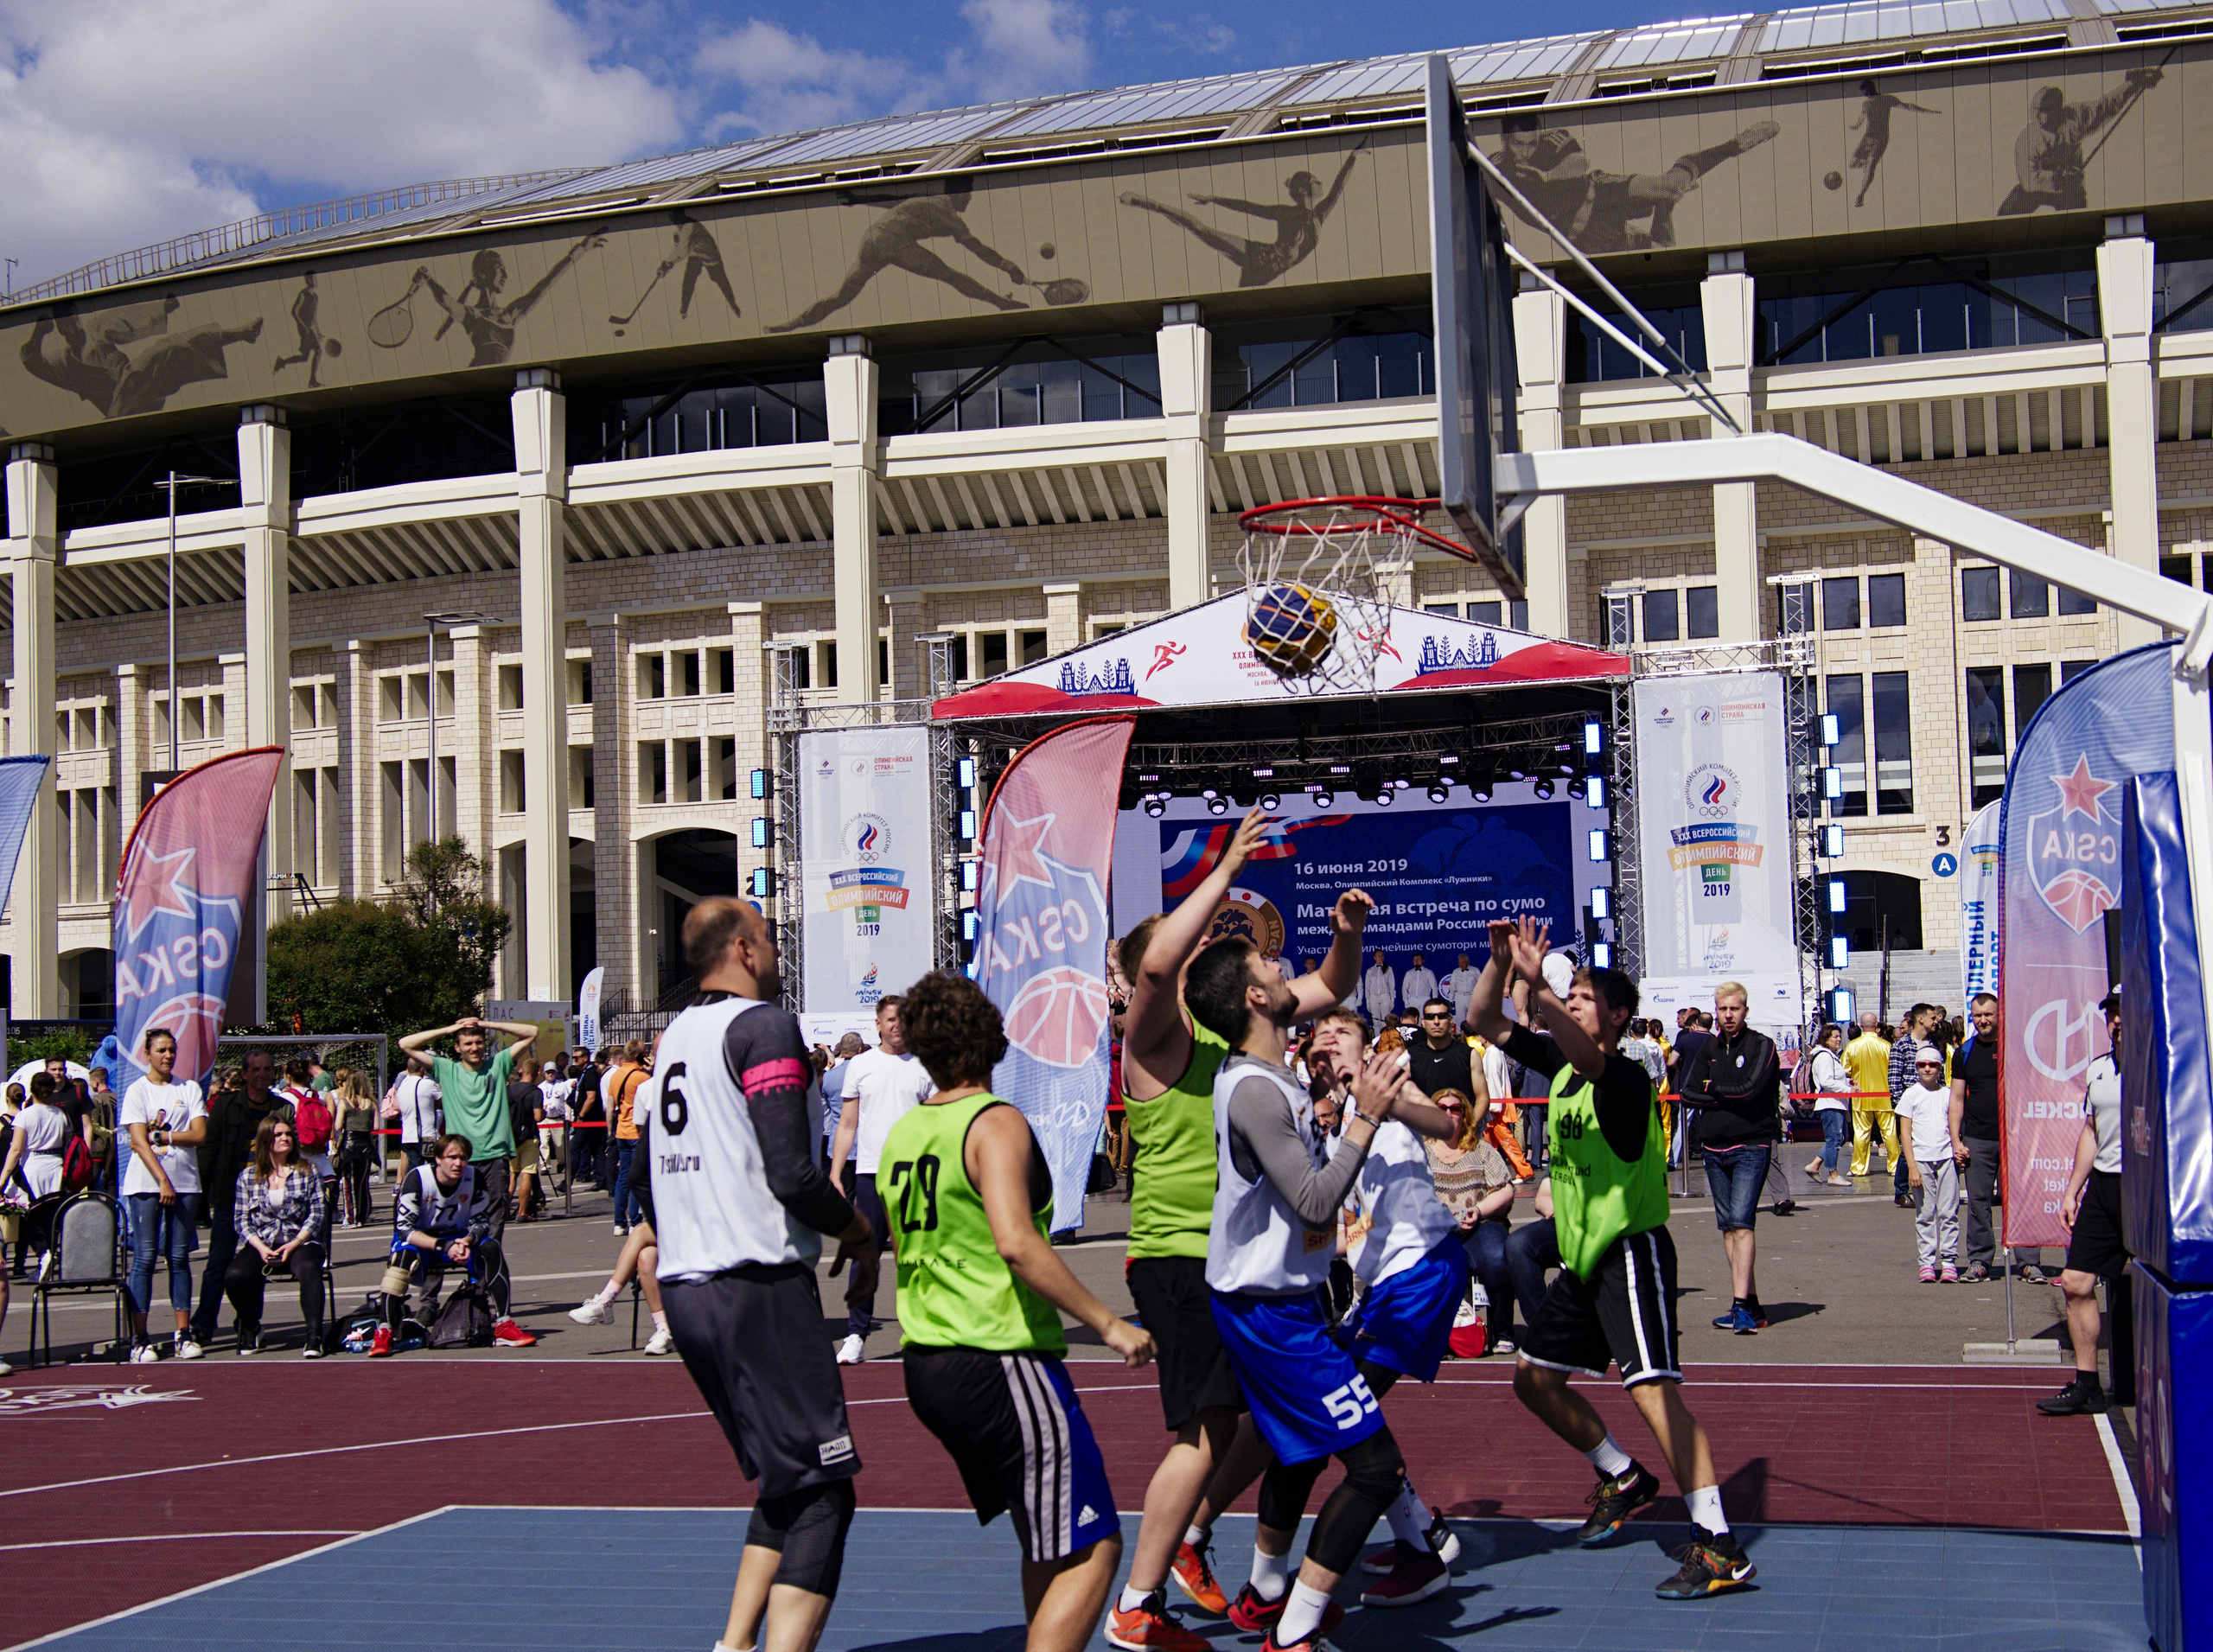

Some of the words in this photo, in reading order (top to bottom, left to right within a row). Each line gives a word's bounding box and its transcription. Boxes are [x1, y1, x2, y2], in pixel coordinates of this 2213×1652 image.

[1721, 702, 1765, 711] ОЛИМПИЙСКАЯ
[1678, 831, 1691, 842] XXX
[1692, 826, 1751, 839] ВСЕРОССИЙСКИЙ
[1936, 826, 1950, 847] 3
[1674, 845, 1757, 864] ОЛИМПИЙСКИЙ
[1294, 863, 1314, 875] 16
[1317, 861, 1363, 874] июня
[1368, 858, 1408, 872] 2019
[1706, 867, 1727, 878] ДЕНЬ
[848, 871, 899, 883] ВСЕРОССИЙСКИЙ
[1296, 882, 1333, 890] Москва,
[1335, 878, 1398, 889] Олимпийский
[1400, 877, 1443, 887] Комплекс
[1444, 875, 1493, 884] «Лужники»
[831, 888, 903, 907] ОЛИМПИЙСКИЙ
[1703, 883, 1731, 897] 2019
[858, 909, 877, 919] ДЕНЬ
[1396, 897, 1470, 916] встреча
[1475, 900, 1497, 911] по
[1502, 897, 1546, 914] сумо
[857, 924, 880, 936] 2019
[1437, 918, 1486, 930] России
[1425, 941, 1476, 953] сумотори
[1709, 960, 1731, 969] 2019
[661, 1062, 688, 1136] 6
[1560, 1113, 1582, 1139] 98
[890, 1154, 940, 1234] 29
[435, 1204, 458, 1222] 77
[1322, 1373, 1379, 1431] 55
